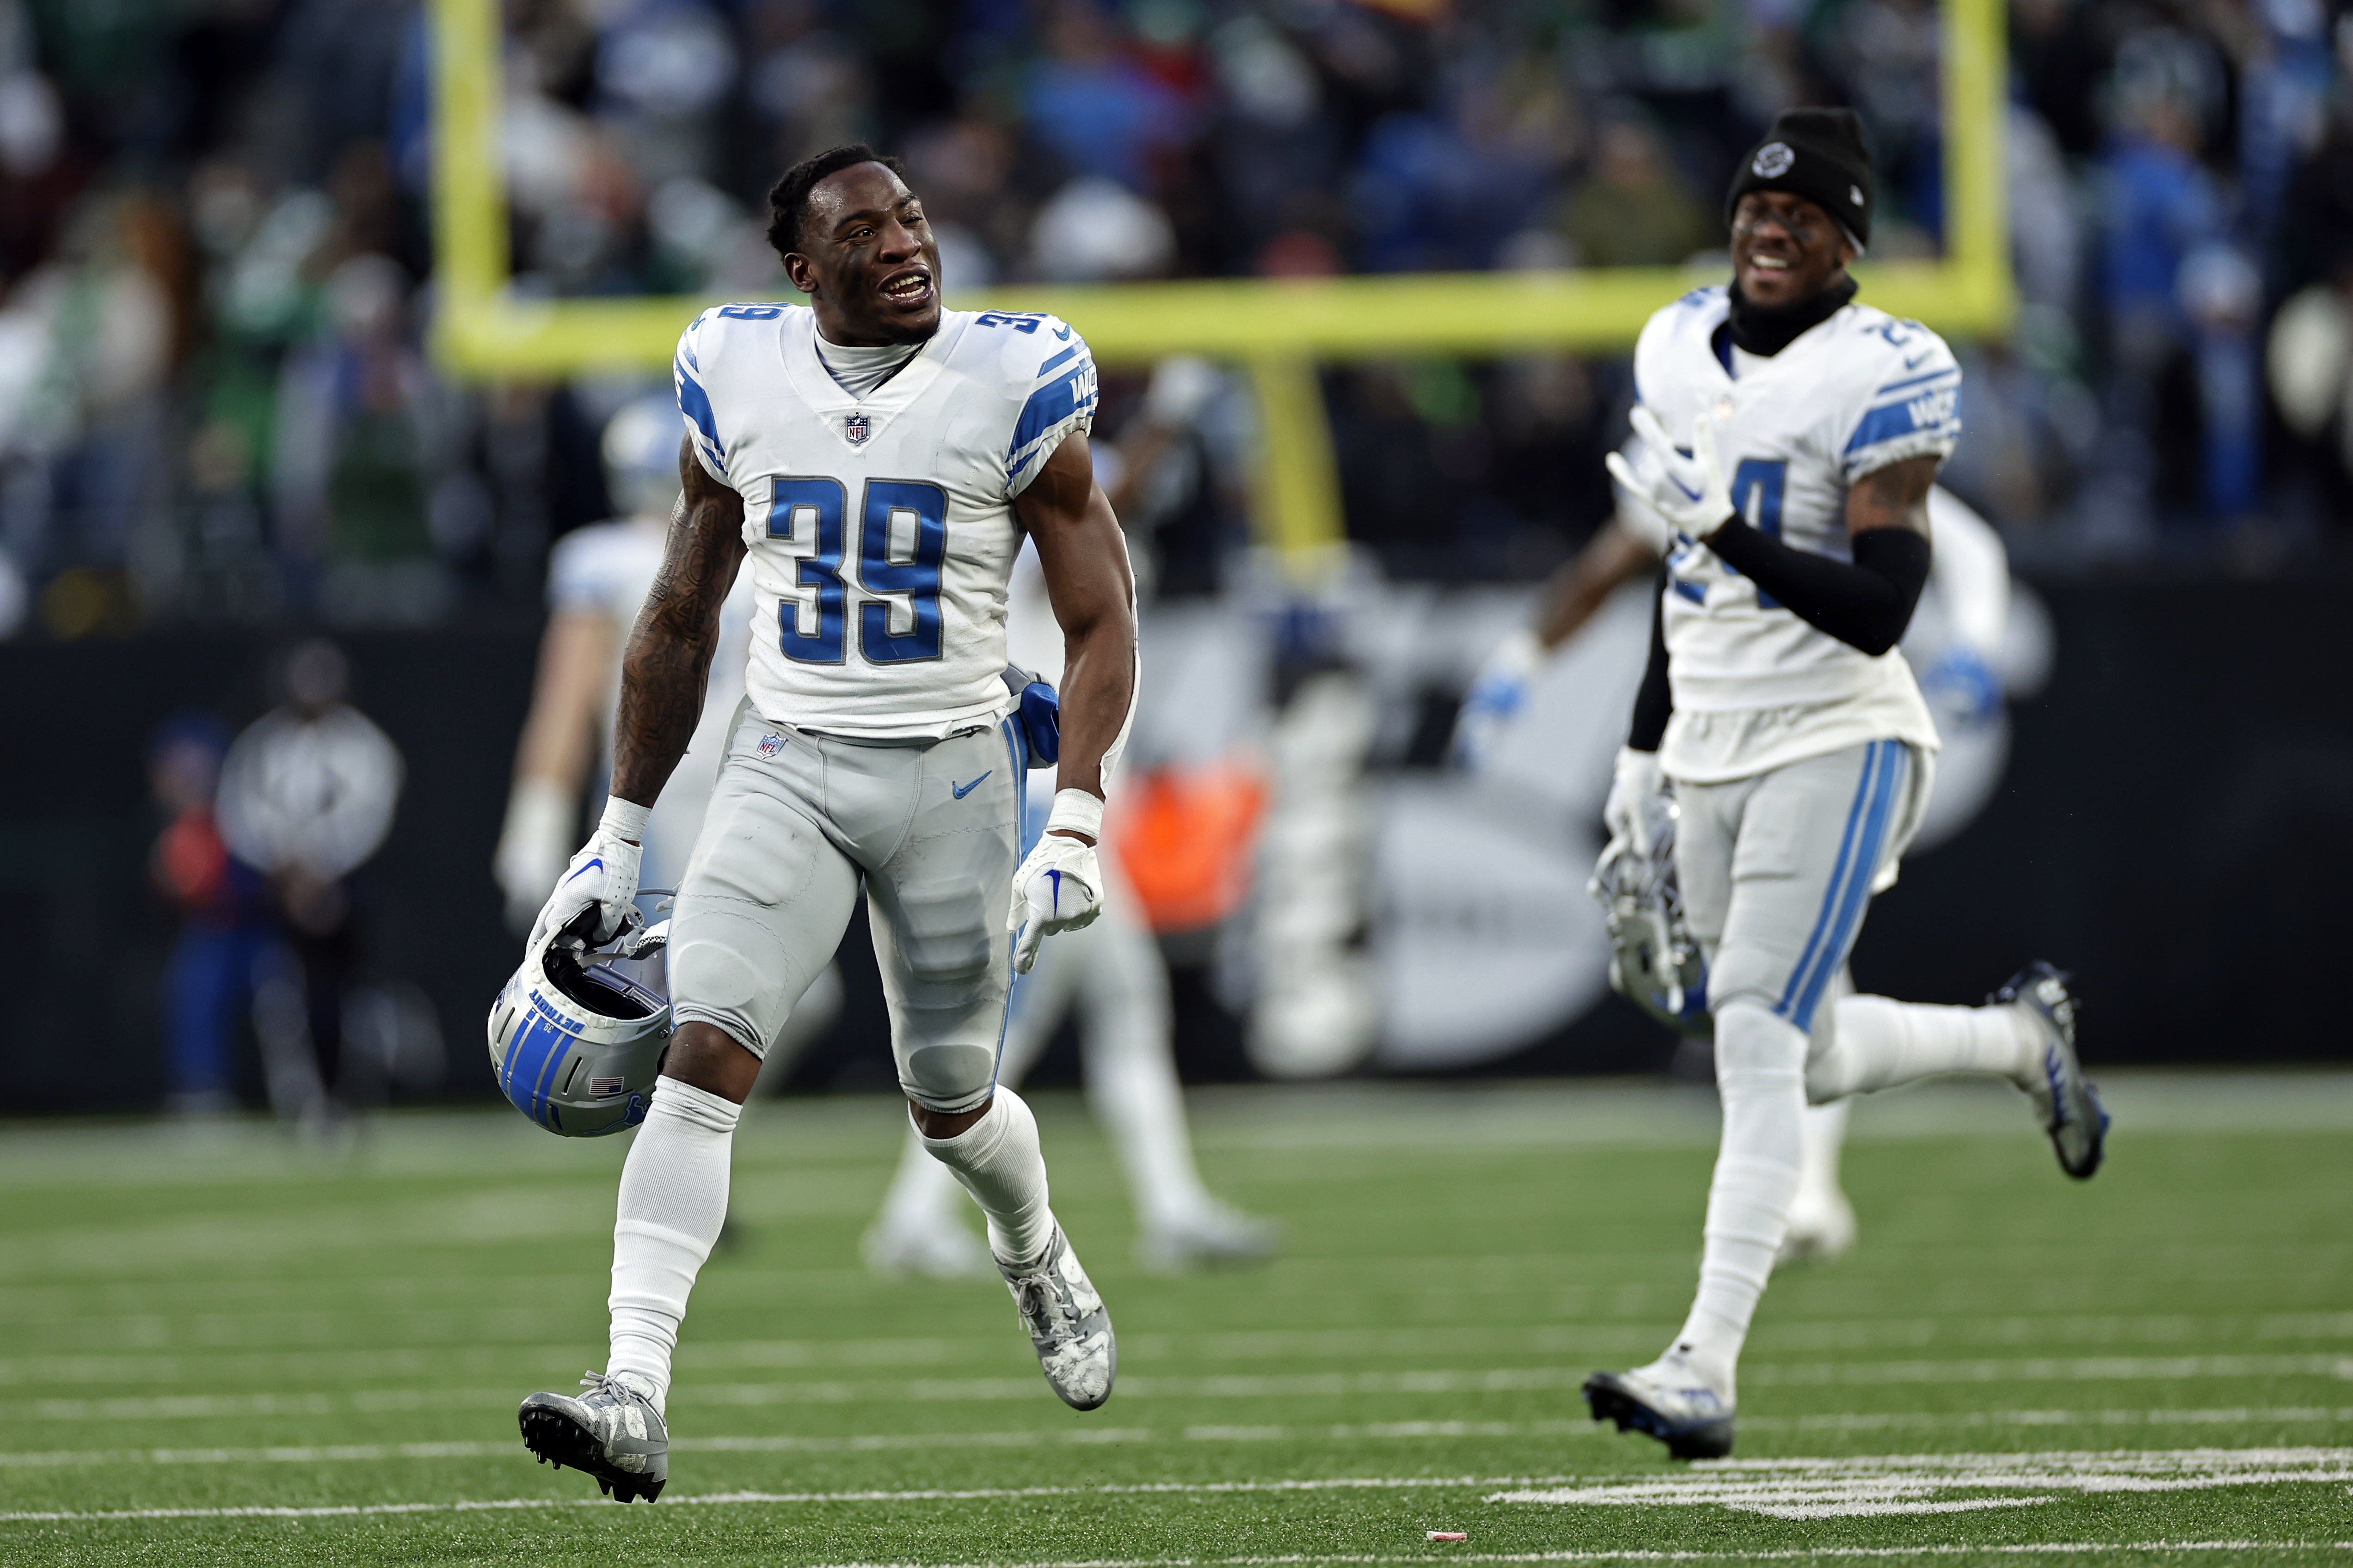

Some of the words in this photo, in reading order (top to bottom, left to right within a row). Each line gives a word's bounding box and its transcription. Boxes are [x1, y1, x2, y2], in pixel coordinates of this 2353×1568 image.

[849, 427, 866, 439] NFL
[765, 475, 949, 666] 39
[759, 742, 776, 753] NFL
[528, 988, 585, 1034] DETROIT
